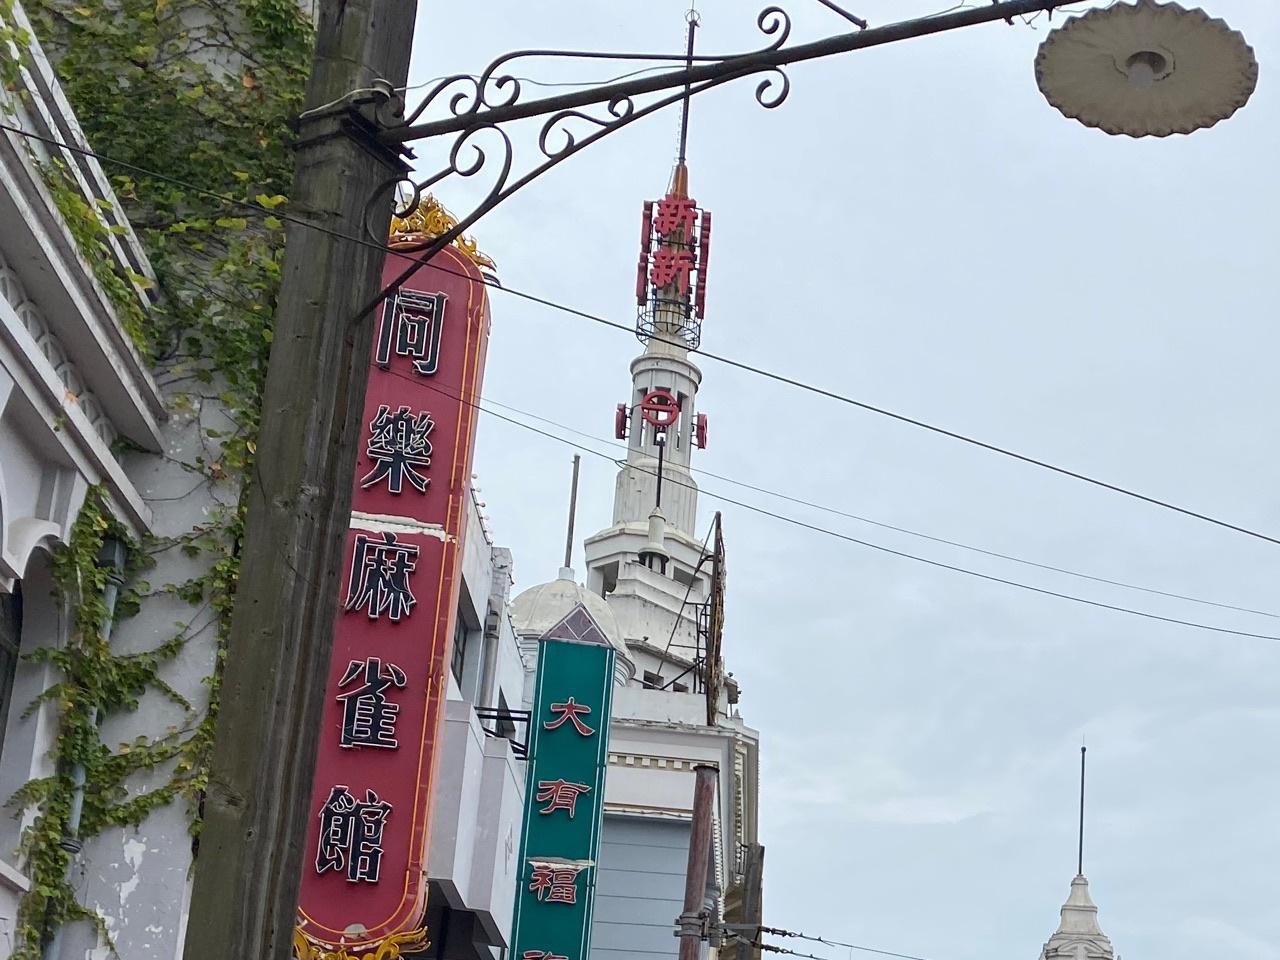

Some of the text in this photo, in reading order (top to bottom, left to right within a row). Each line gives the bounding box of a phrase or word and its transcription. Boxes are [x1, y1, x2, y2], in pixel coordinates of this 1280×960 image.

[652, 194, 698, 296] 新新
[315, 288, 449, 882] 同樂麻雀館
